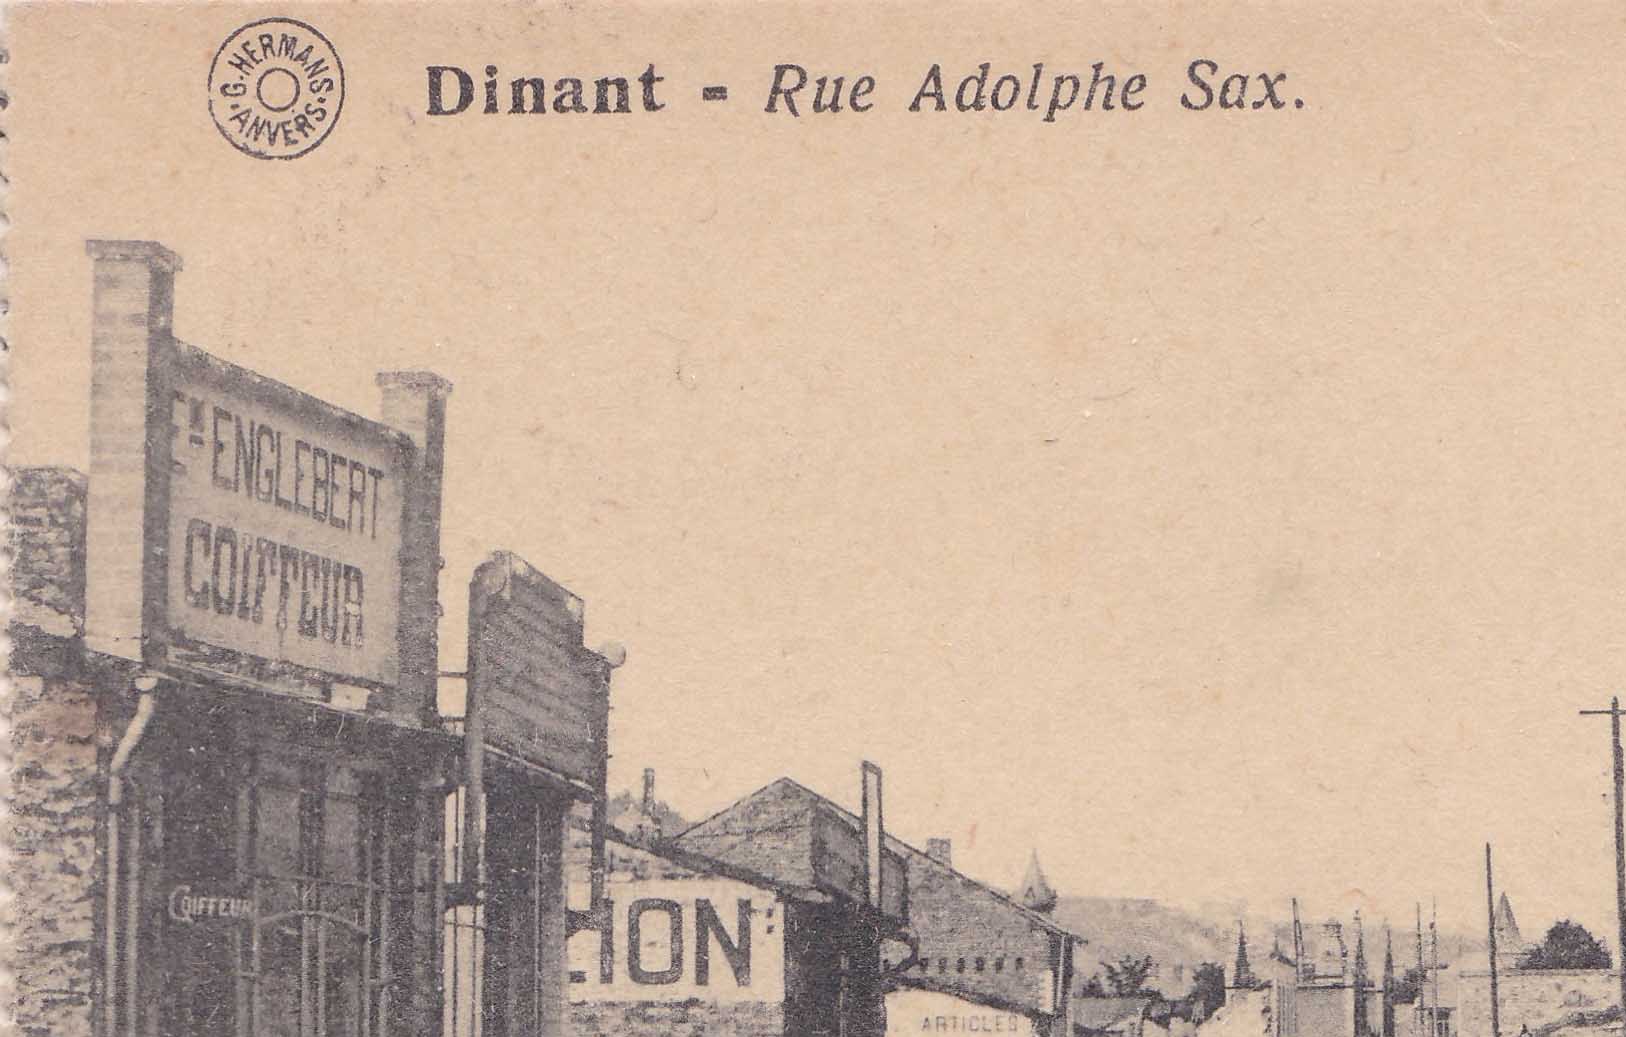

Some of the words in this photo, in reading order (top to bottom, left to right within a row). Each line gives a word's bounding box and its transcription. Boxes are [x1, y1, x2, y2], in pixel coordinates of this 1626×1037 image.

[212, 405, 385, 540] ENGLEBERT
[184, 517, 364, 650] COIFFEUR
[920, 1015, 1018, 1032] ARTICLES
